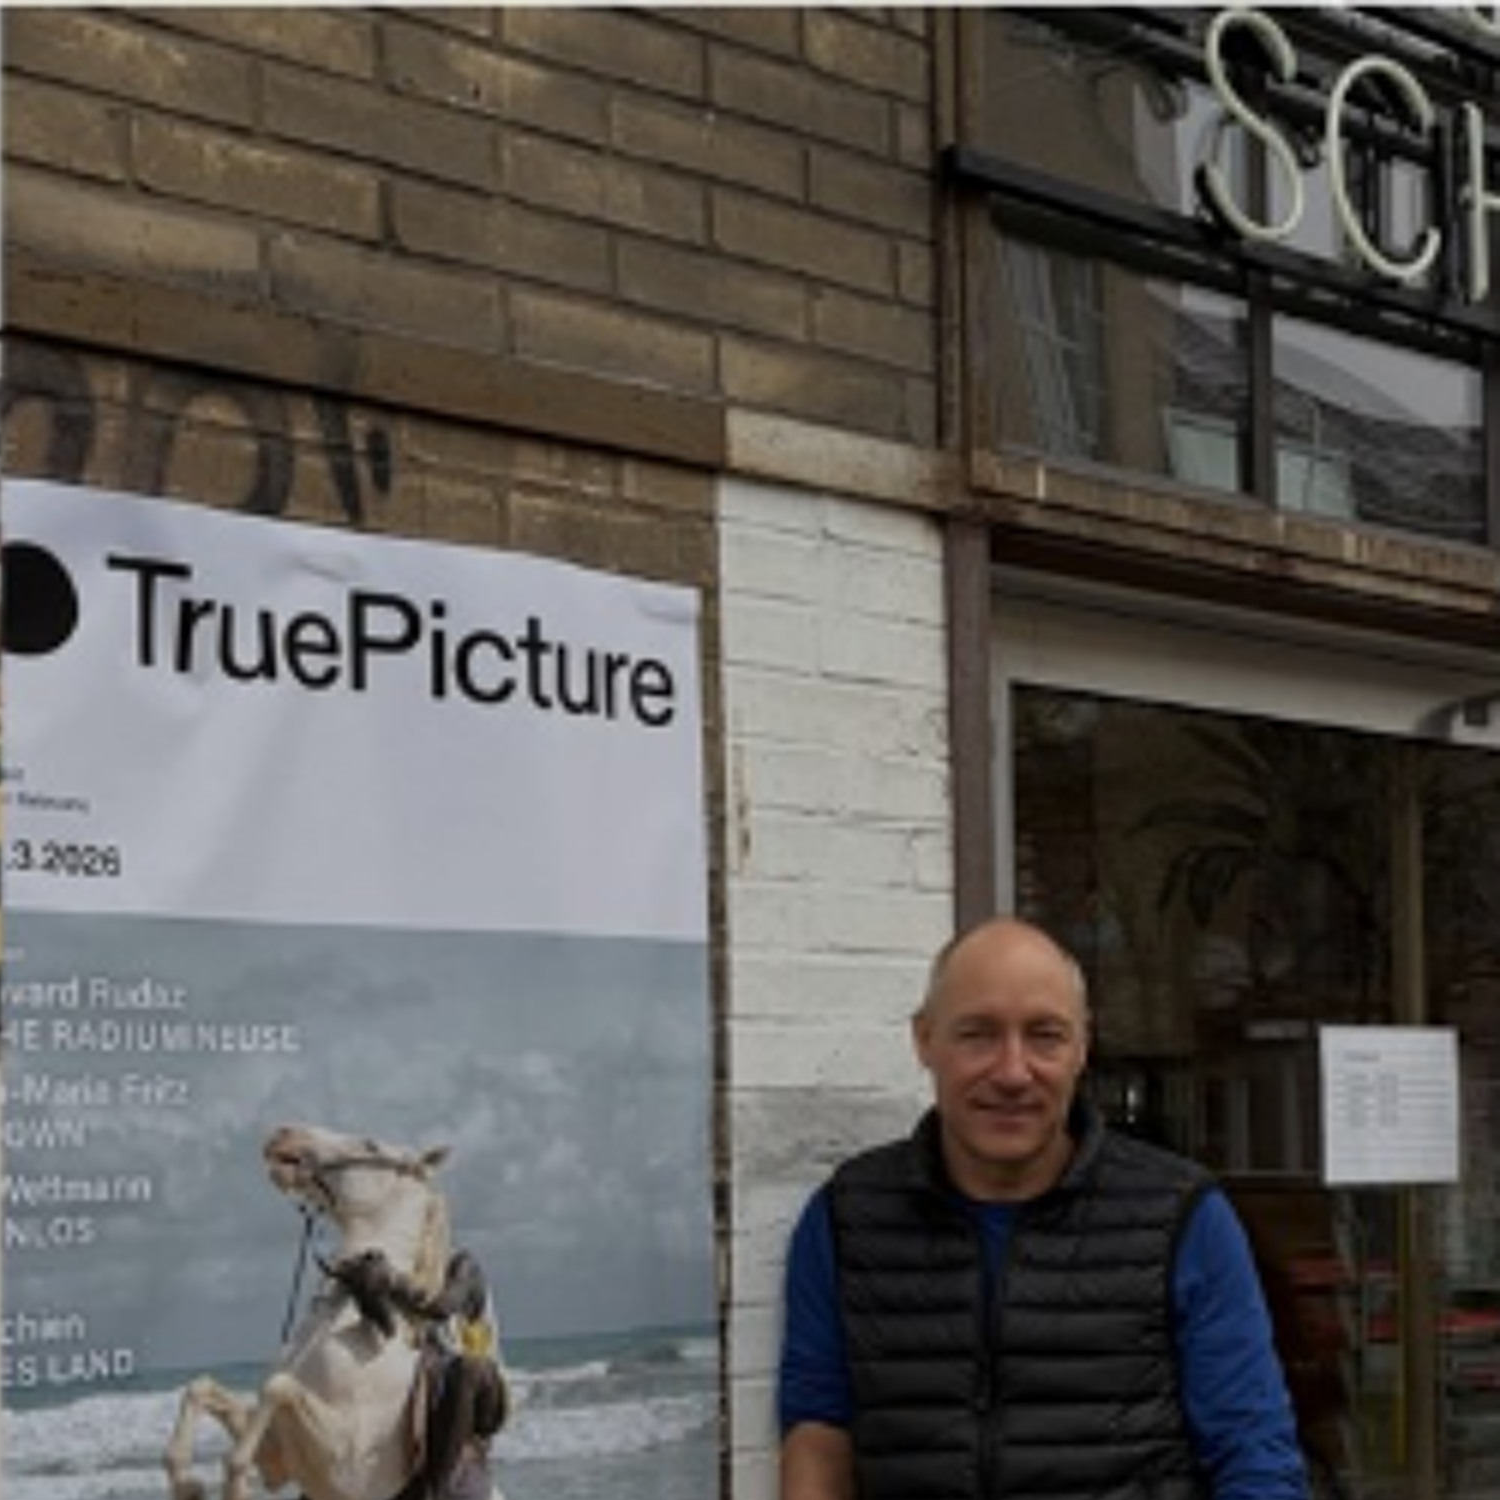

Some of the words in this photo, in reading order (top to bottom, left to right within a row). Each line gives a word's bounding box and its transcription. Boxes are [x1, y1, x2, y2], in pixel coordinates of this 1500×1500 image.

[106, 553, 676, 727] TruePicture
[51, 1018, 300, 1052] RADIUMINEUSE
[47, 1348, 134, 1385] LAND
